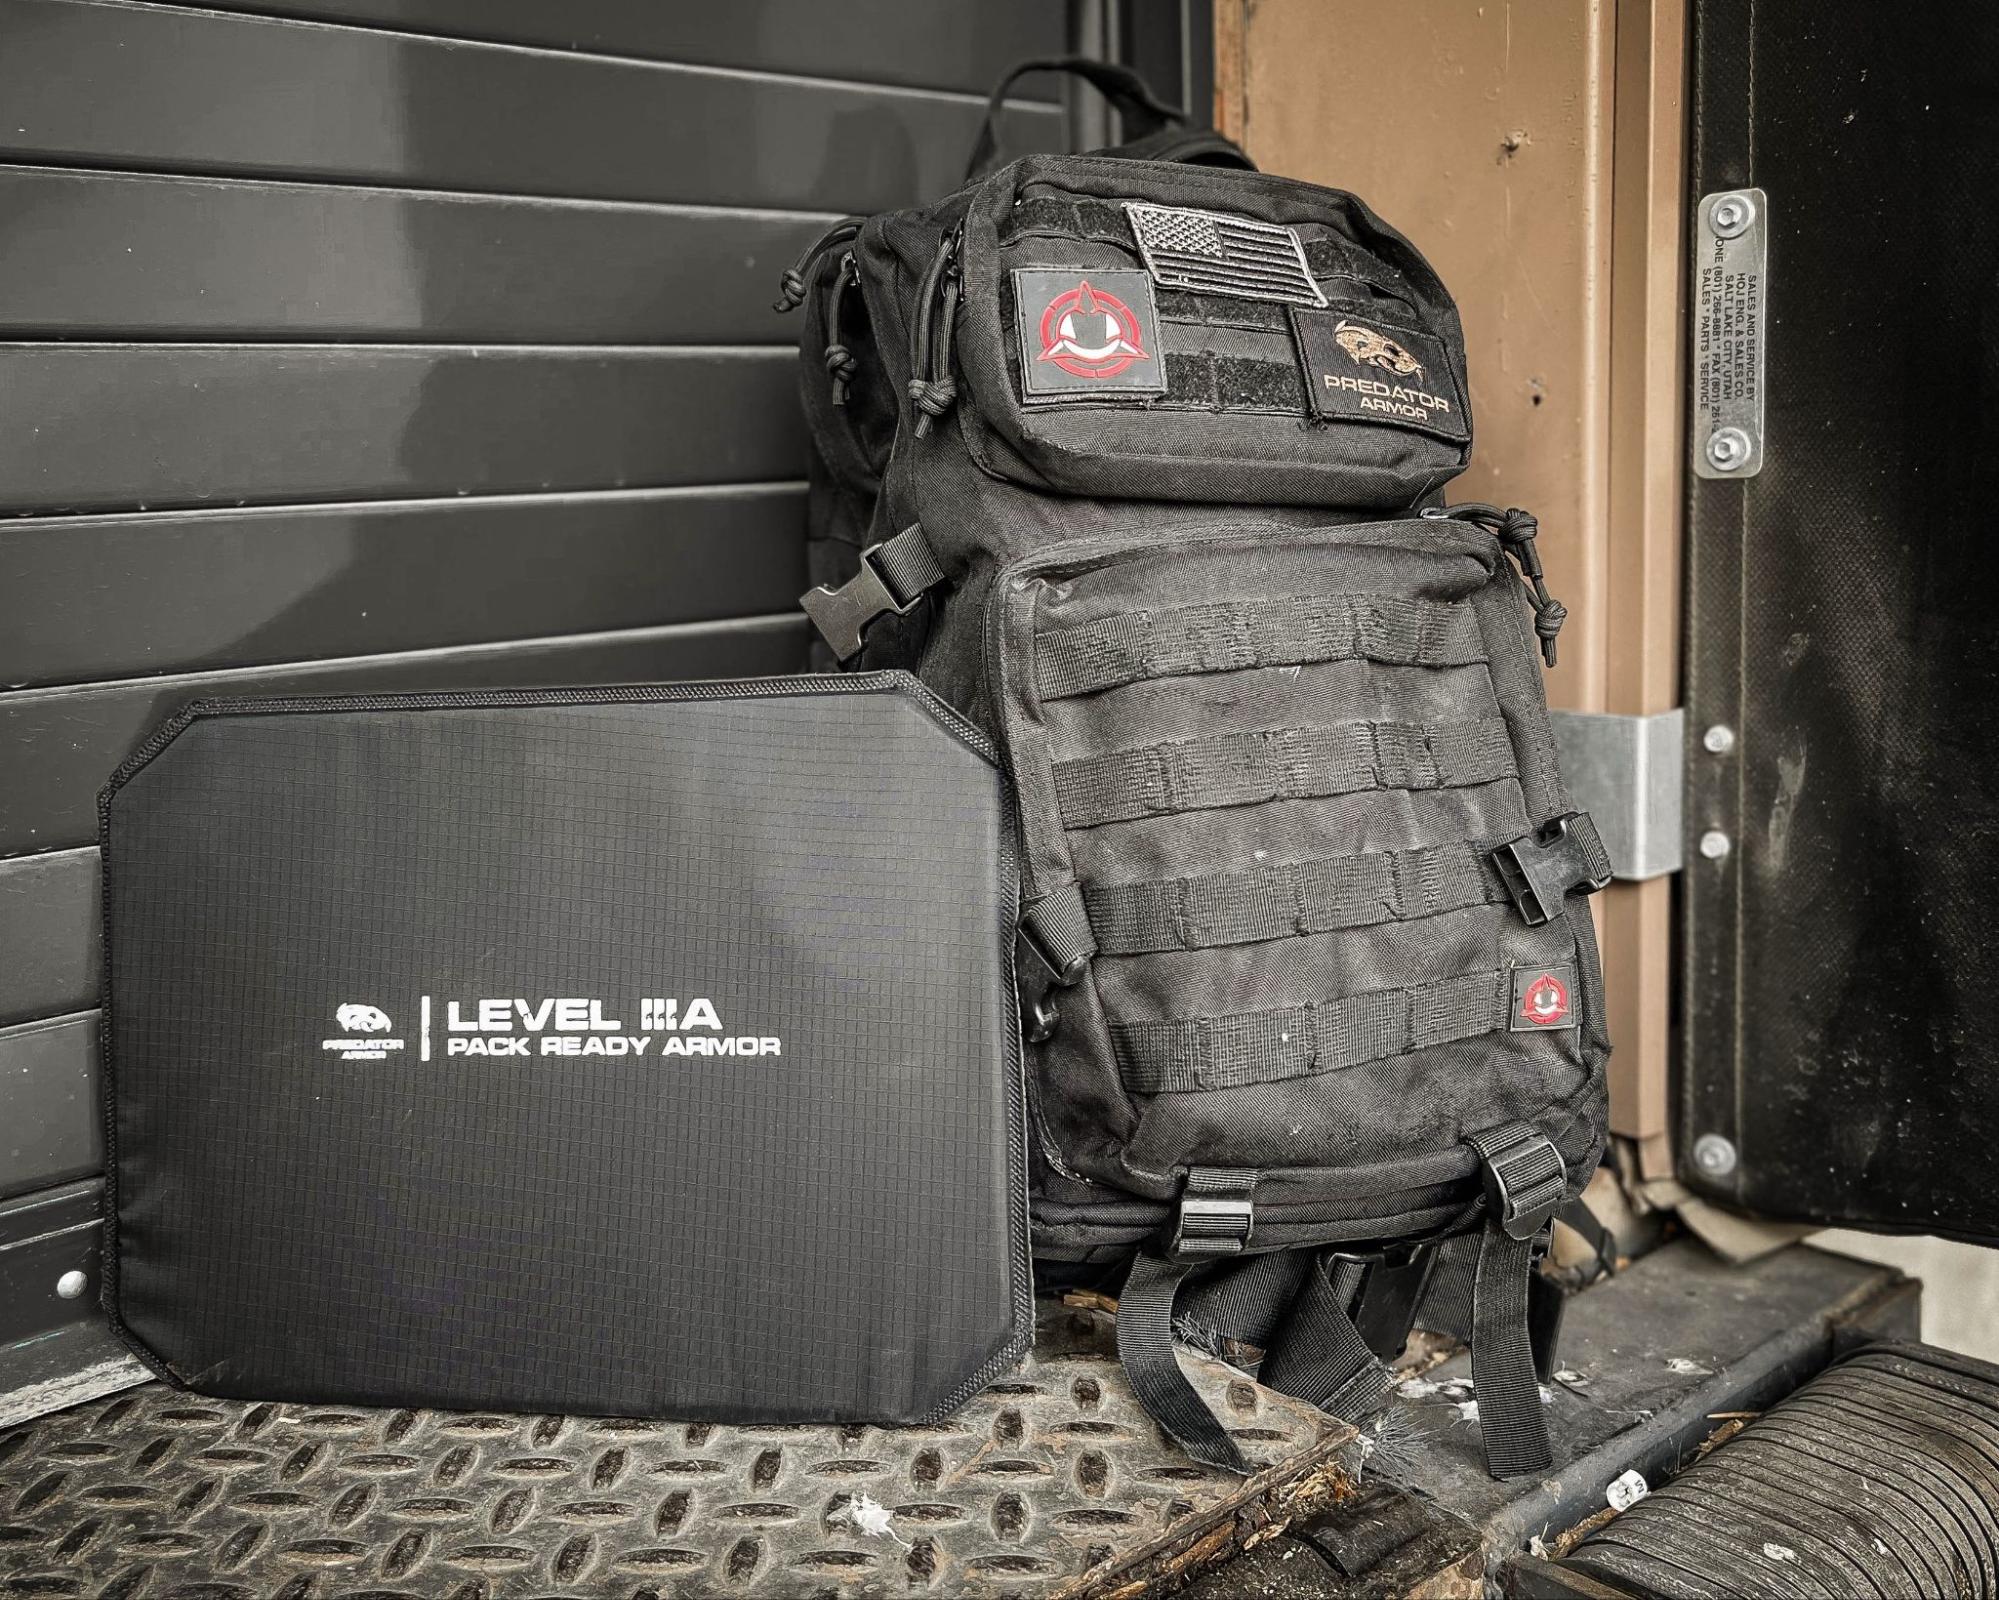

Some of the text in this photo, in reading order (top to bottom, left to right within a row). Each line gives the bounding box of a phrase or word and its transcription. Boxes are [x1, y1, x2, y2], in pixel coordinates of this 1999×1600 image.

[1715, 235, 1724, 263] ONE
[1712, 266, 1723, 292] (801)
[1700, 268, 1711, 410] SALES PARTS SERVICE
[1723, 275, 1734, 400] SALT LAKE CITY, UTAH
[1734, 273, 1746, 400] HOJ ENG. & SALES CO.
[1746, 275, 1757, 401] SALES AND SERVICE BY
[1712, 353, 1721, 374] FAX
[1323, 374, 1450, 413] PREDATOR
[1710, 377, 1721, 403] (801)
[1360, 397, 1428, 421] ARMOR
[447, 998, 724, 1032] LEVEL IIIA
[447, 1036, 782, 1057] PACK READY ARMOR
